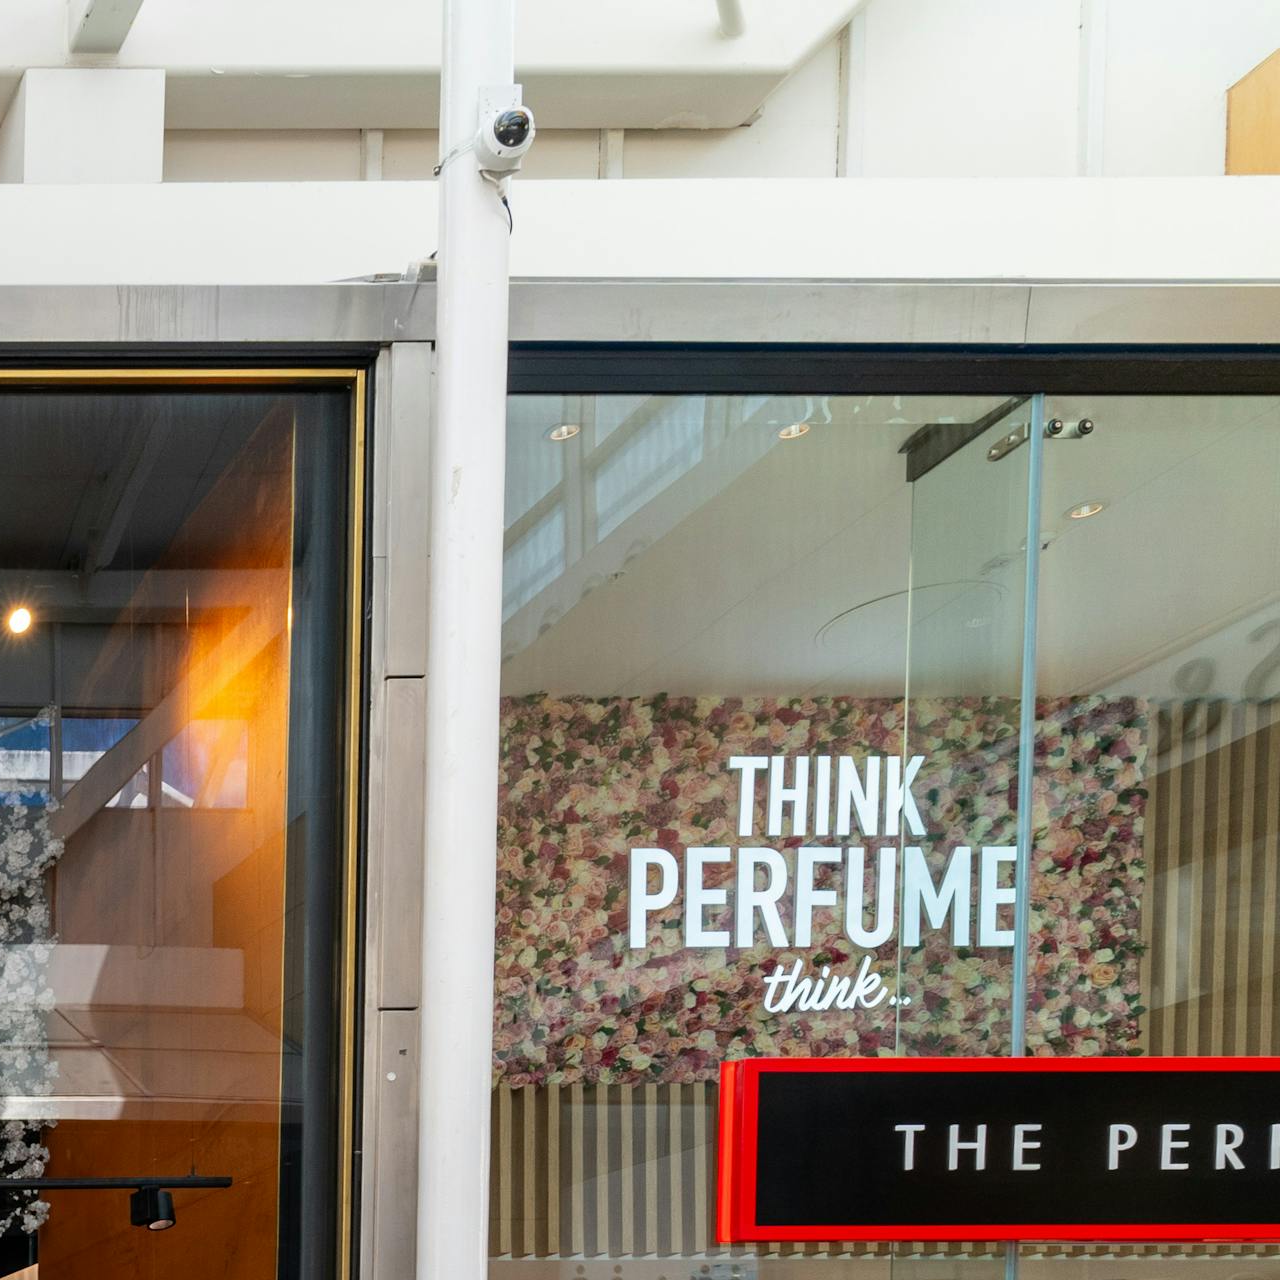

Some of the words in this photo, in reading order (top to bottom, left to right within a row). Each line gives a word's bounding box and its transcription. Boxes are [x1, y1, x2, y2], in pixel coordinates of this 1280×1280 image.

[728, 755, 927, 837] THINK
[628, 845, 1018, 949] PERFUME
[894, 1123, 1042, 1171] THE
